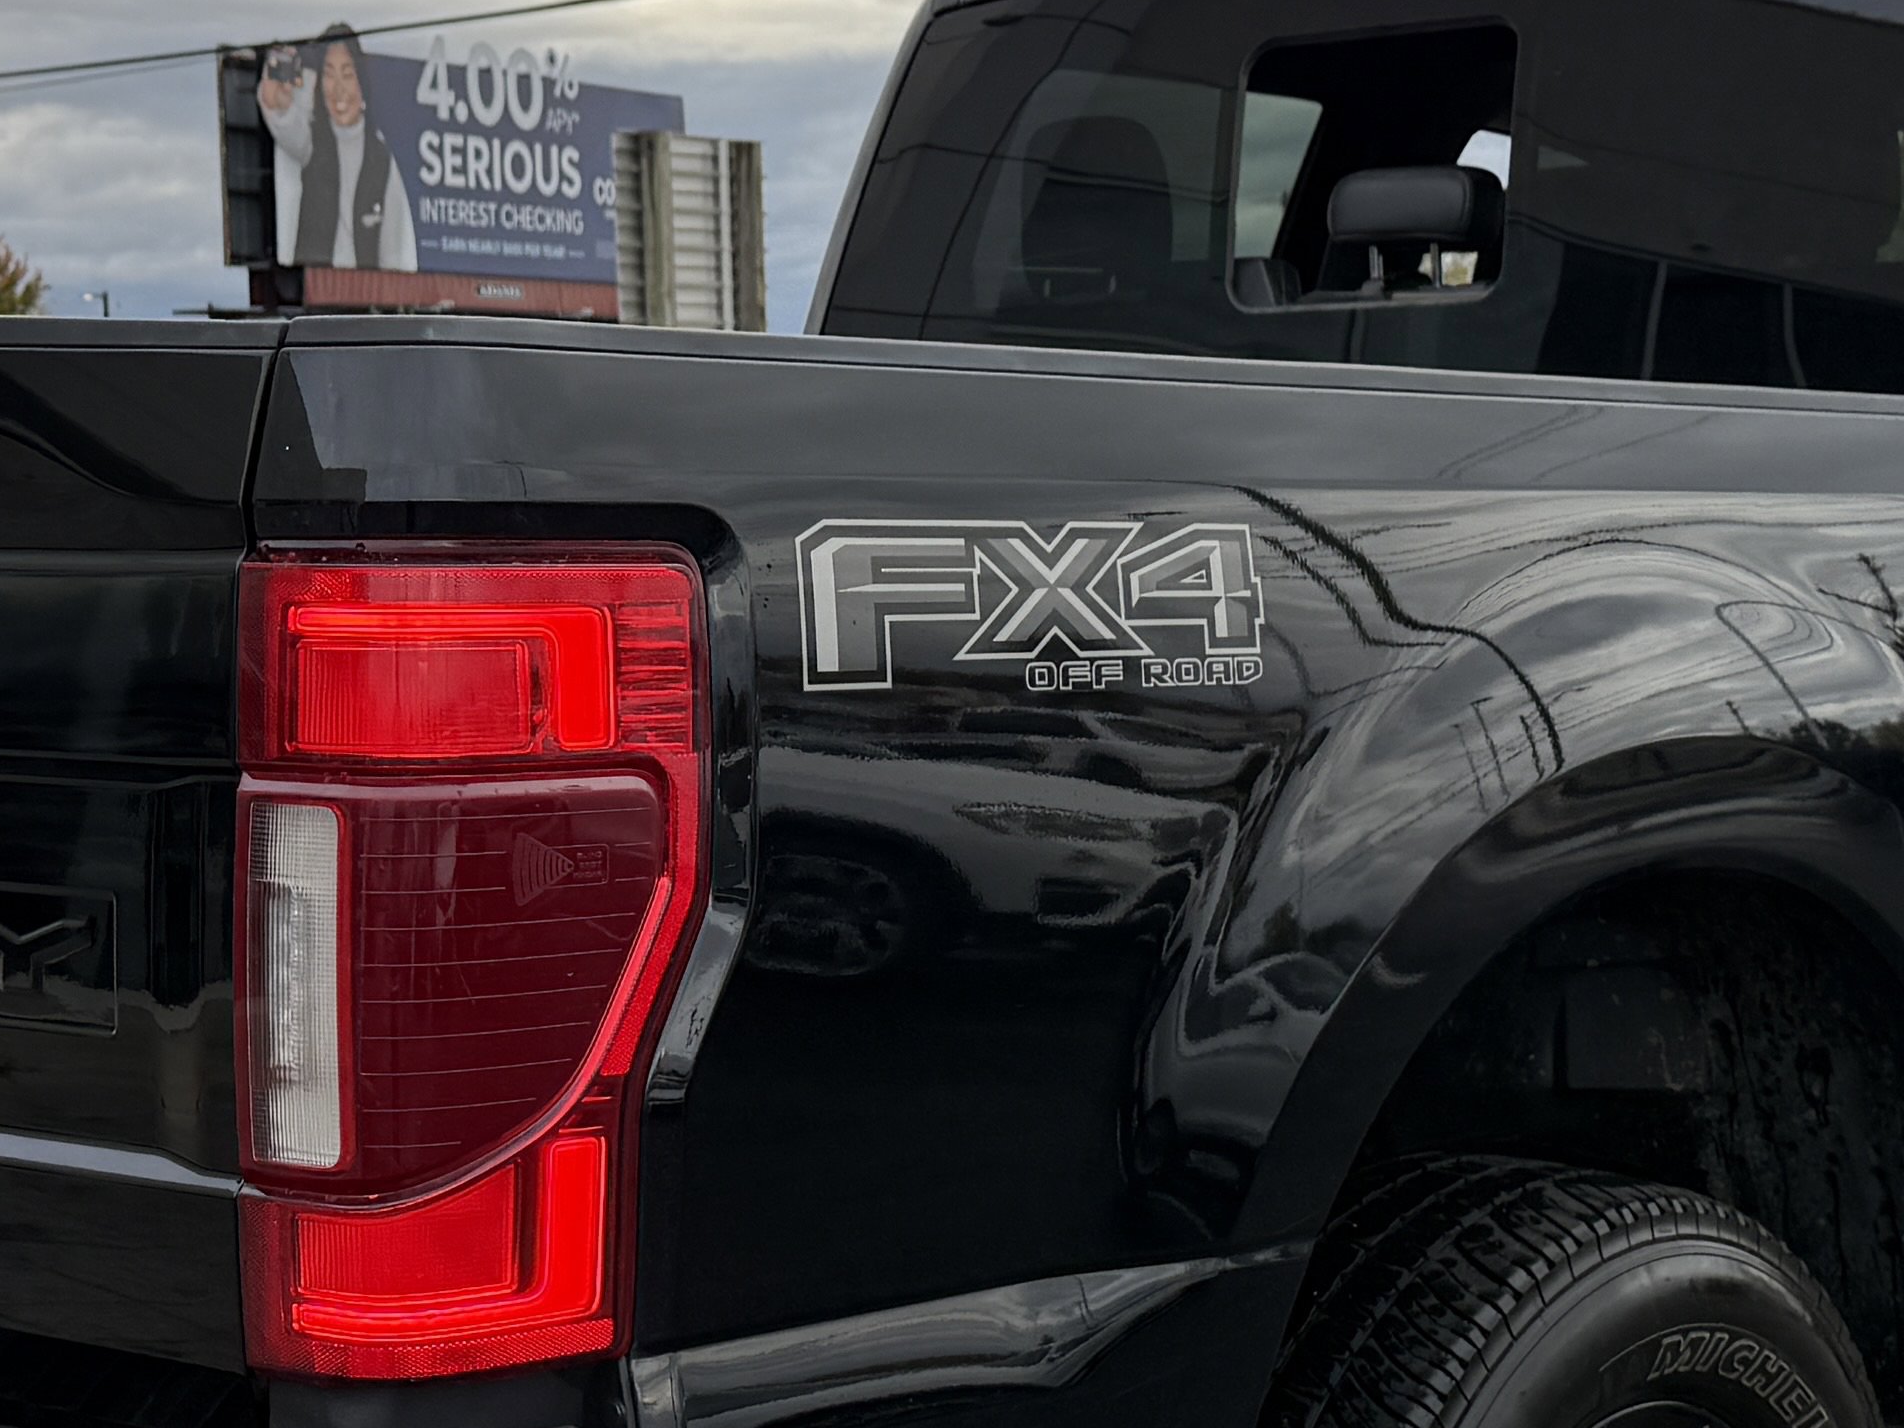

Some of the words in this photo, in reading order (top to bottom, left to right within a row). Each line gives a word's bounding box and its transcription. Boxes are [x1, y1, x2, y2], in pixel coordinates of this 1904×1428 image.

[418, 129, 582, 199] SERIOUS
[419, 196, 497, 228] INTEREST
[500, 202, 585, 236] CHECKING
[796, 519, 1264, 691] FX4
[1025, 658, 1124, 691] OFF
[1141, 656, 1264, 689] ROAD
